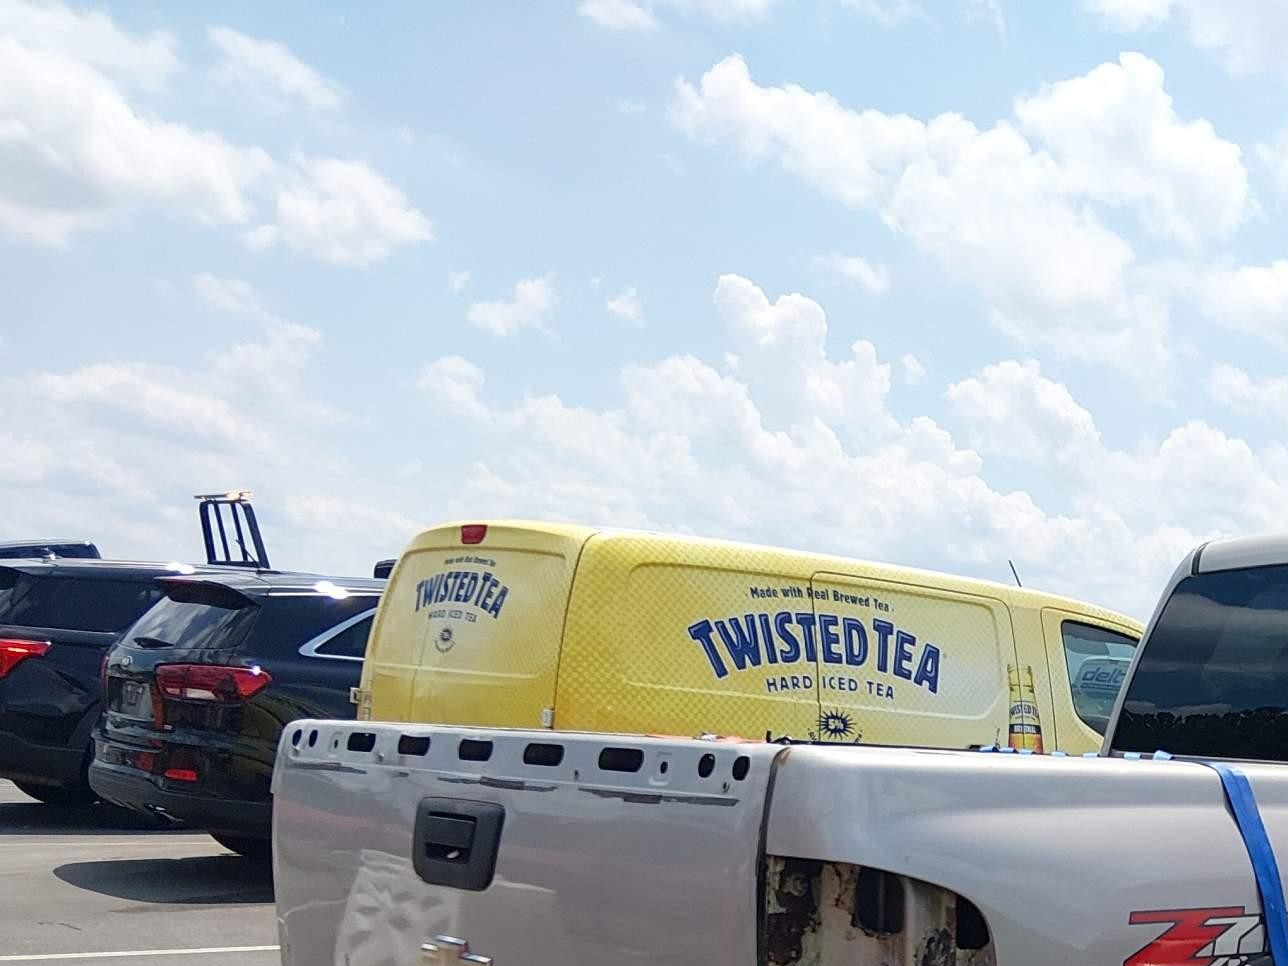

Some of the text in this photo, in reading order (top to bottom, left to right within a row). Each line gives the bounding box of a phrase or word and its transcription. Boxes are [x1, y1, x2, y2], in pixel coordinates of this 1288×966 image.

[415, 571, 509, 619] TWISTED TEA
[750, 586, 889, 612] Made with Real Brewed Tea
[687, 611, 941, 694] TWISTED TEA
[766, 676, 894, 700] HARD ICED TEA
[1081, 667, 1125, 684] delt
[1009, 703, 1031, 717] WISTED
